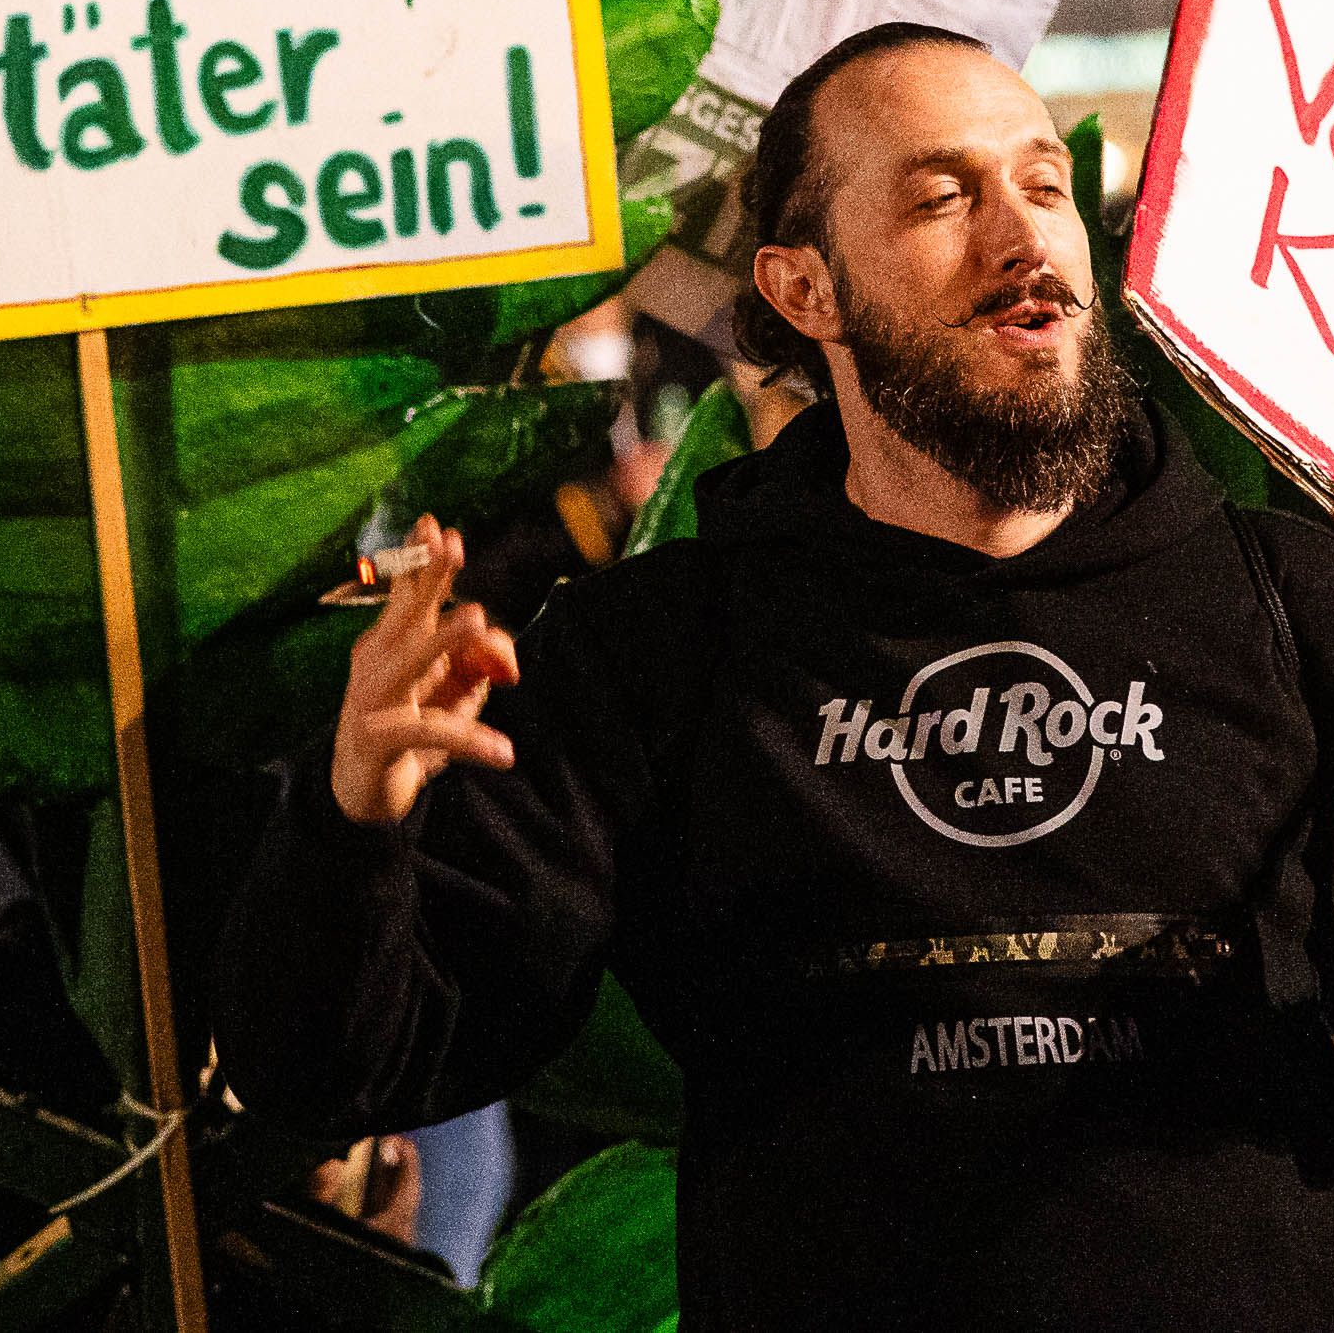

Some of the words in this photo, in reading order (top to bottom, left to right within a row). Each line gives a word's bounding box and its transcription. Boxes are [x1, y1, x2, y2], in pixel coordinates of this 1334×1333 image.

[217, 44, 545, 269] sein!
[814, 688, 992, 766] Hard
[998, 680, 1167, 767] Rock
[954, 776, 1045, 809] CAFE
